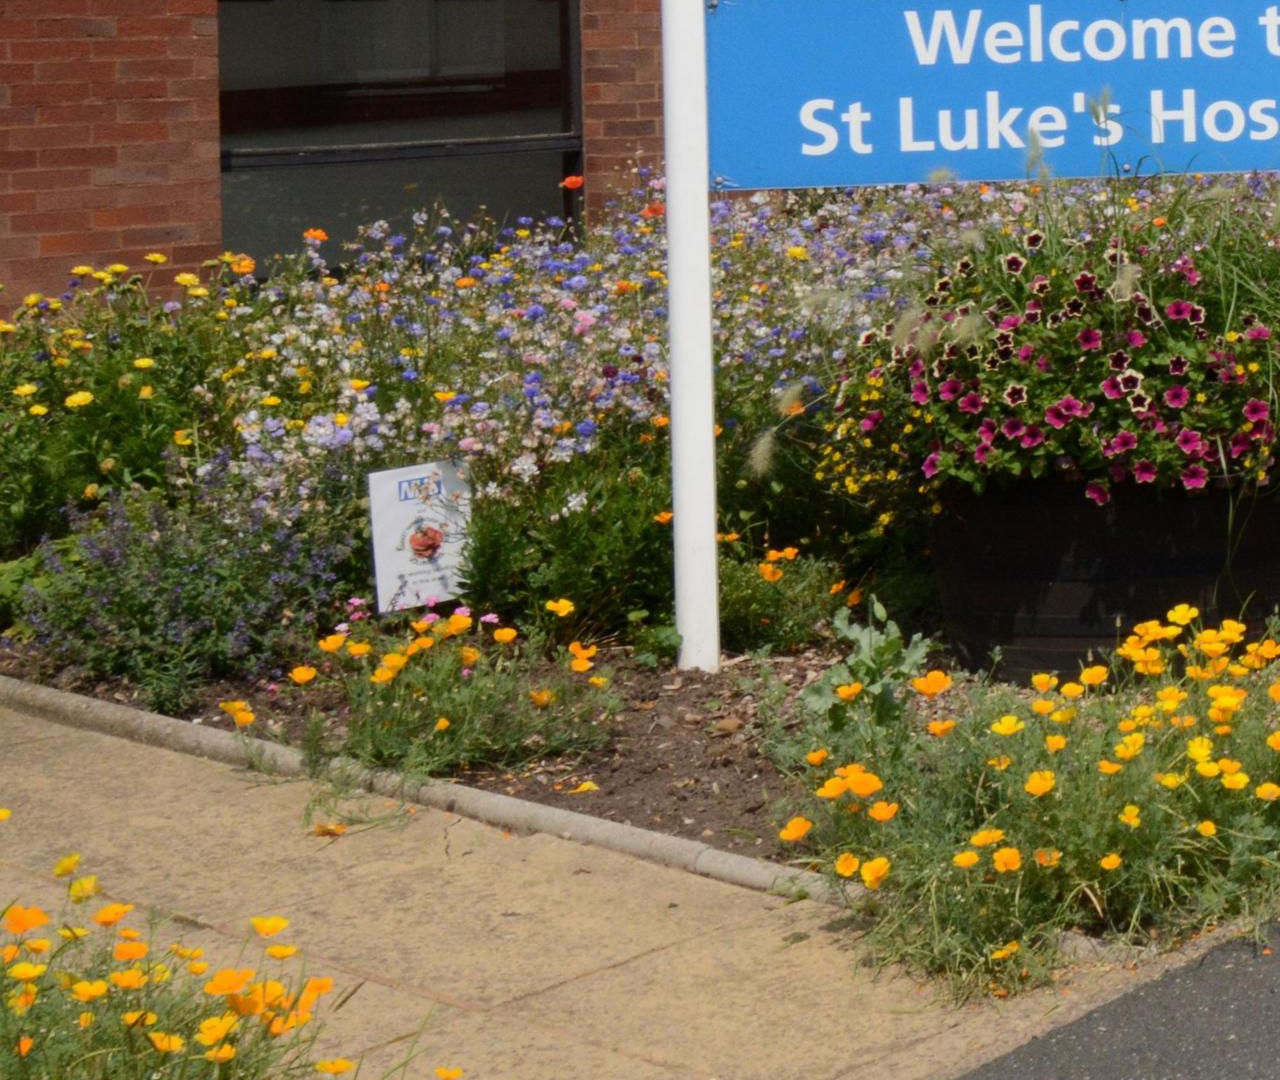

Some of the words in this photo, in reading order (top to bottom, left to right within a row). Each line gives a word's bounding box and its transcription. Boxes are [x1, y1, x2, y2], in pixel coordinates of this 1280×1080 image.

[903, 4, 1237, 66] Welcome
[799, 98, 873, 156] St
[899, 90, 1125, 152] Luke's
